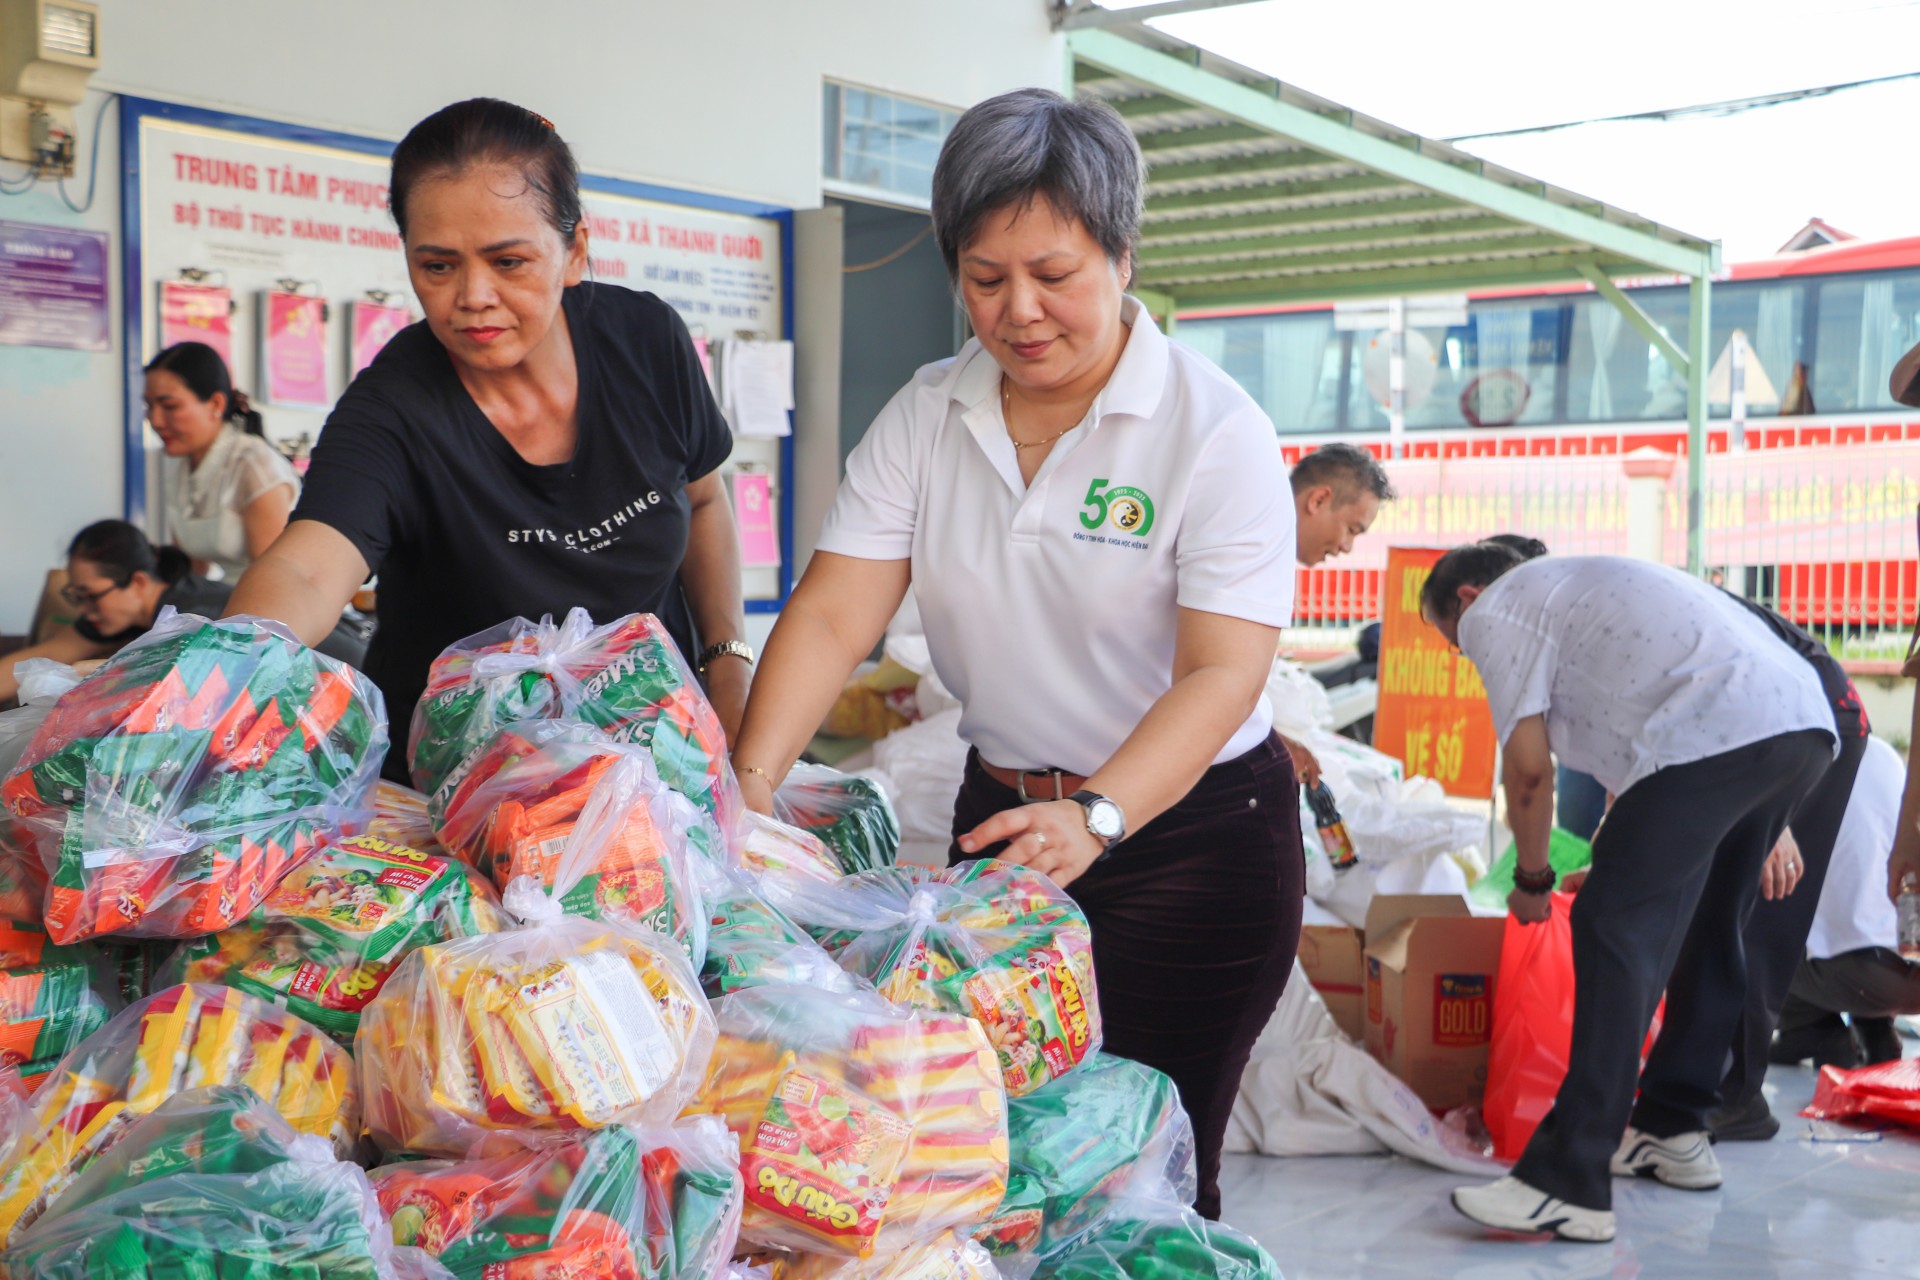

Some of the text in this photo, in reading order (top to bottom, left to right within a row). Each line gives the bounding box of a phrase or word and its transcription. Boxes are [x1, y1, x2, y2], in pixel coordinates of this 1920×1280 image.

[172, 153, 258, 191] TRUNG
[267, 159, 319, 200] TÂM
[173, 203, 402, 252] BỘ THỦ TỤC HÀNH CHÍNH
[564, 491, 661, 546] CLOTHING
[1384, 636, 1450, 698] KHÔNG
[1405, 715, 1468, 782] VÉ SỐ
[403, 873, 425, 885] chay
[1440, 1000, 1486, 1034] GOLD
[757, 1132, 778, 1144] tôm
[760, 1122, 798, 1139] chua cay
